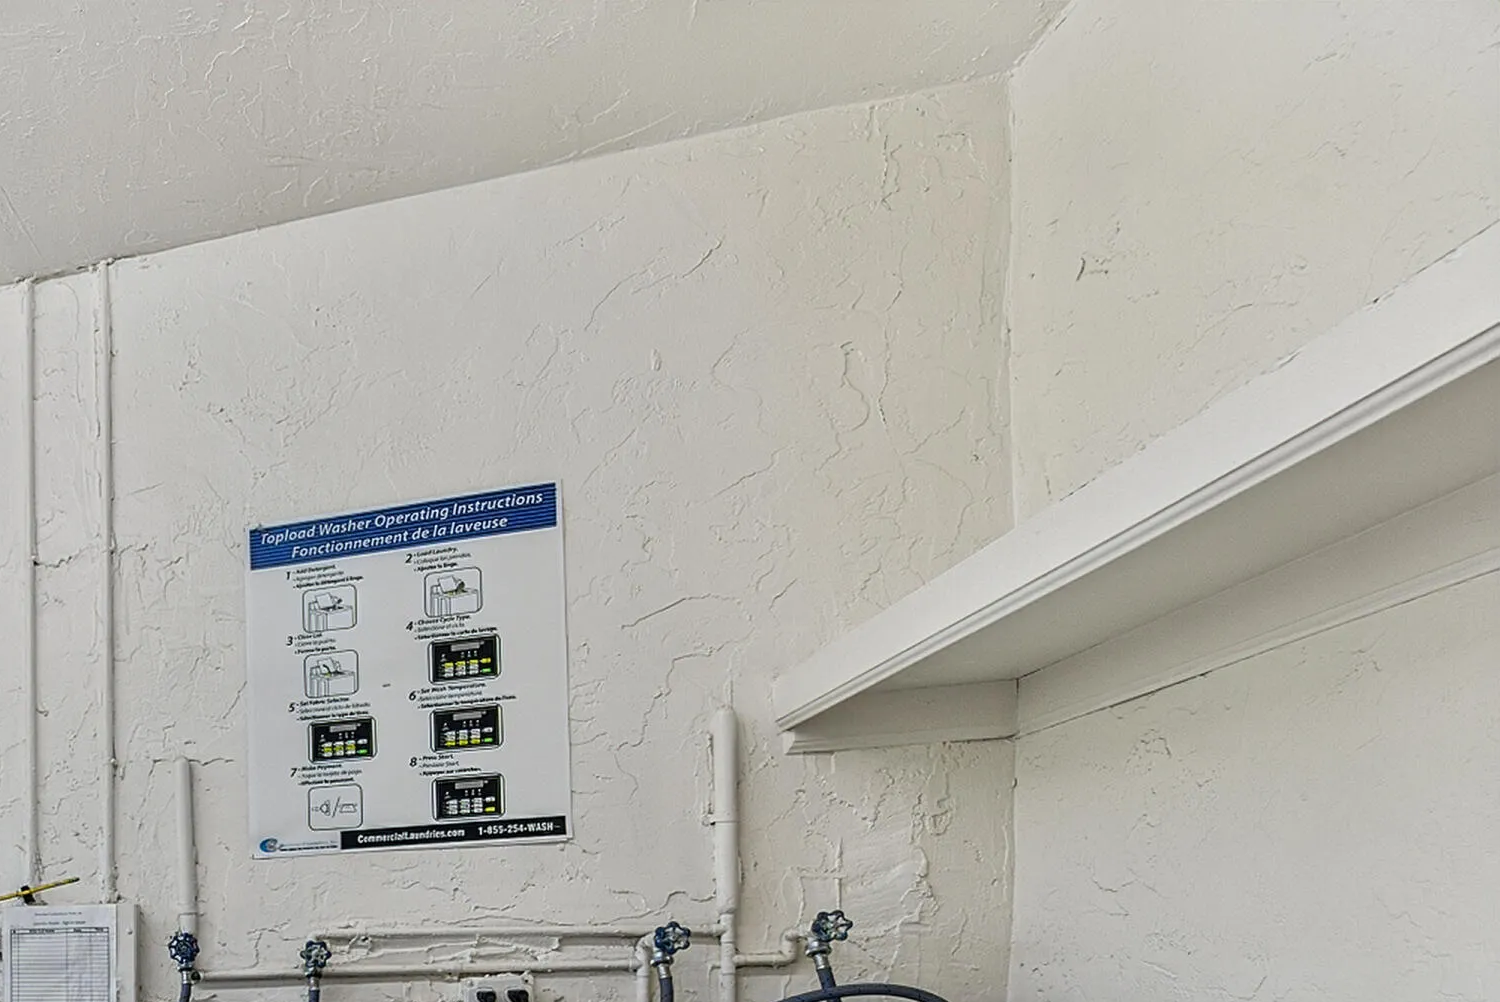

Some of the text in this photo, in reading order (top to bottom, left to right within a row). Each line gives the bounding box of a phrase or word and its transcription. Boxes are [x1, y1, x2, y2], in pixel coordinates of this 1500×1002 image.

[261, 493, 543, 548] Topload Washer Operating Instructions
[292, 517, 508, 558] Fonctionnement de la laveuse
[405, 553, 412, 564] 2
[286, 571, 292, 580] 1
[405, 620, 413, 631] 4
[286, 636, 293, 646] 3
[408, 690, 416, 701] 6
[288, 702, 296, 713] 5
[409, 756, 417, 767] 8
[291, 767, 297, 778] 7
[357, 828, 466, 844] CommercialLaundries.com
